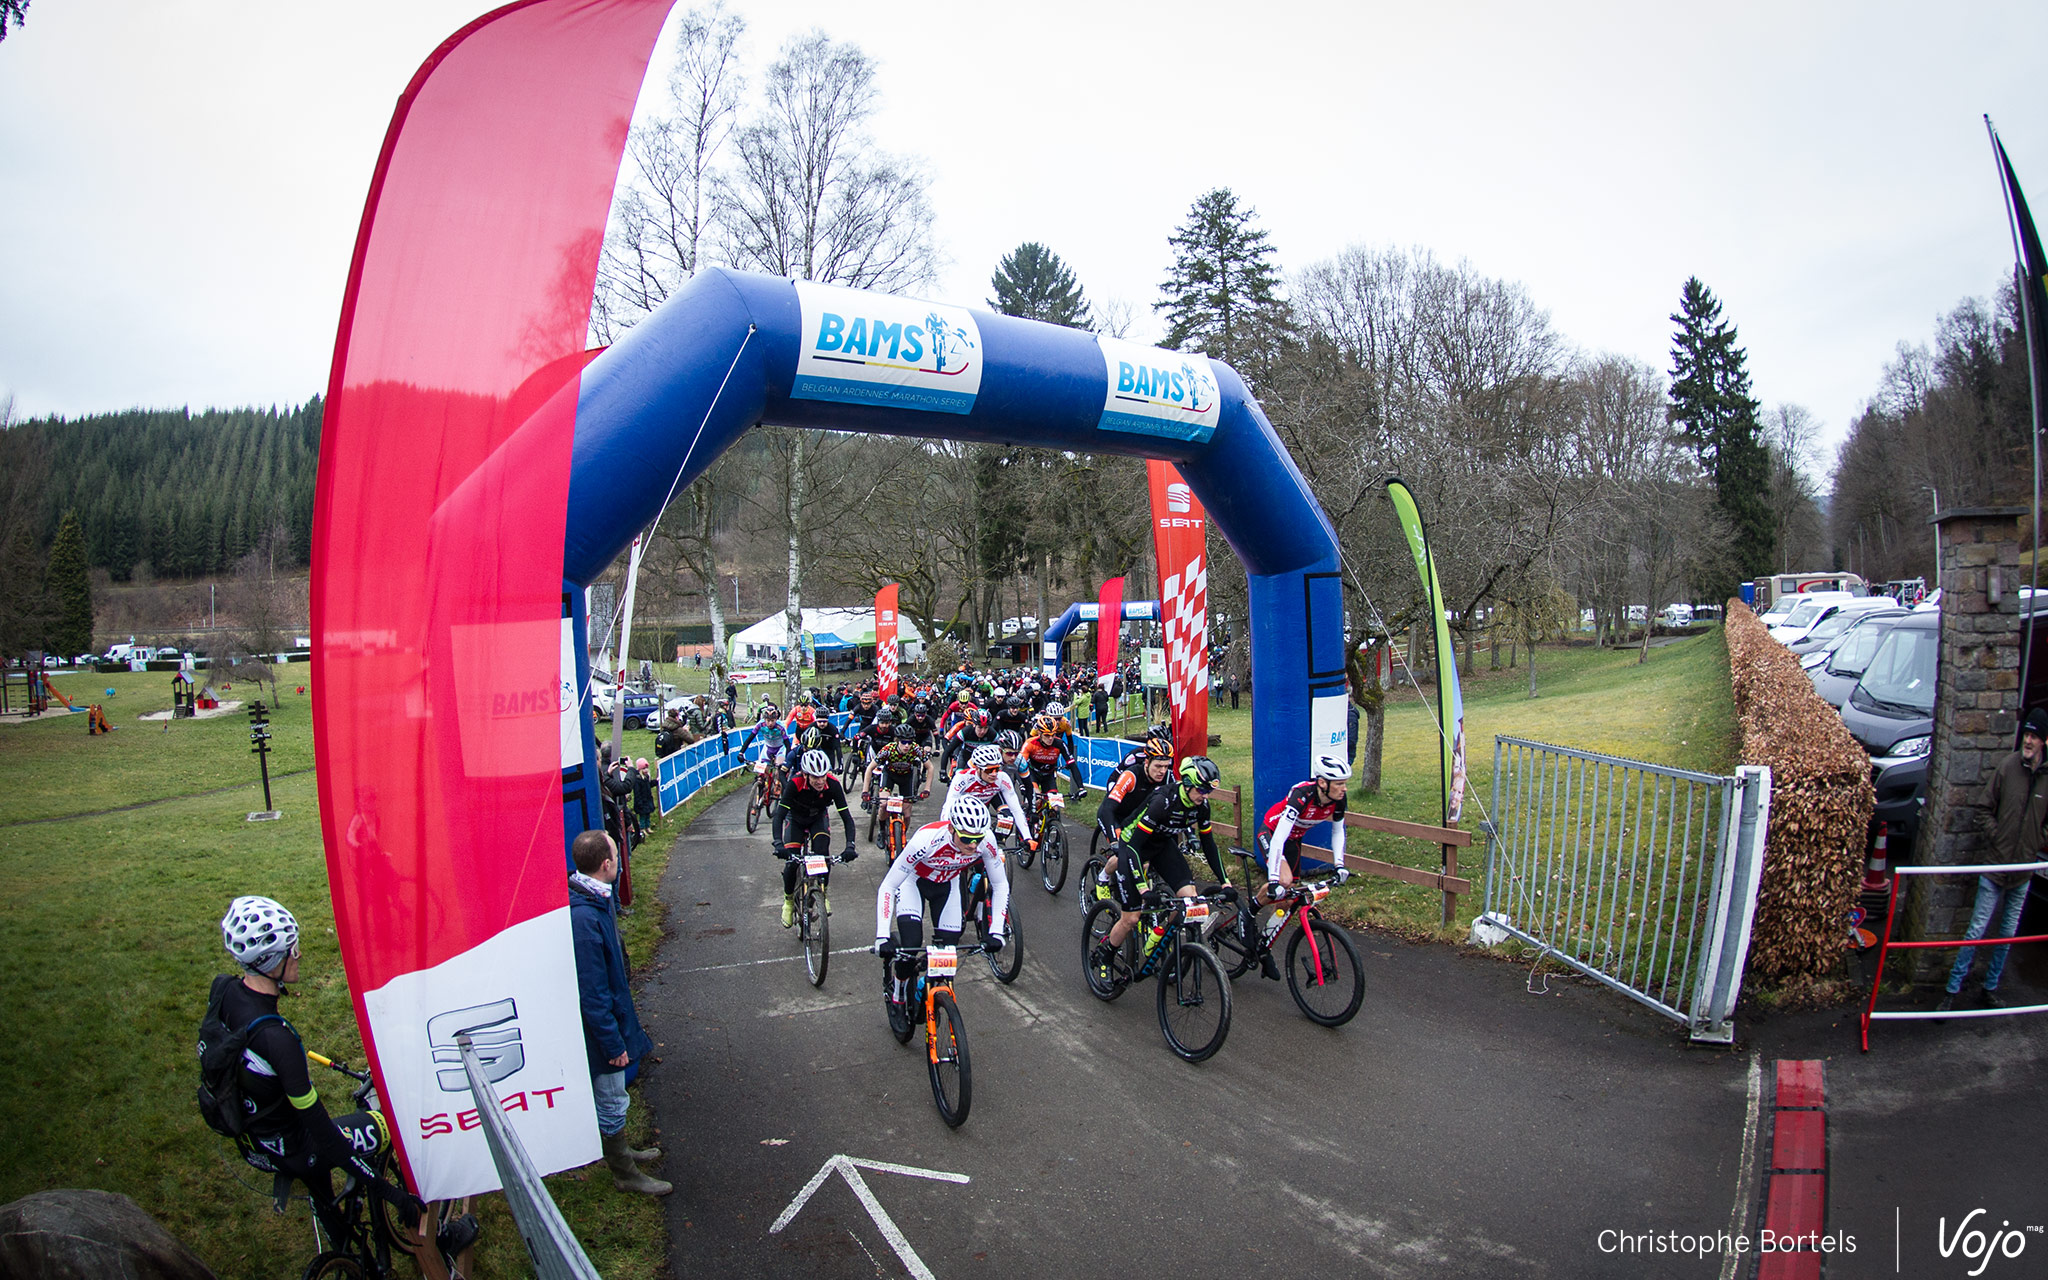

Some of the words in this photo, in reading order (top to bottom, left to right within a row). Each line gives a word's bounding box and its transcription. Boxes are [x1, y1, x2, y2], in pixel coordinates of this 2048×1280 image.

[814, 312, 925, 363] BAMS
[801, 382, 841, 395] BELGIAN
[842, 386, 889, 400] ARDENNES
[891, 392, 938, 405] MARATHON
[940, 398, 967, 408] SERIES
[1117, 361, 1186, 402] BAMS
[1160, 518, 1203, 528] SEAT
[492, 689, 550, 717] BAMS
[1091, 758, 1119, 768] ORBEA
[932, 958, 953, 968] 7501
[419, 1086, 565, 1140] SEAT
